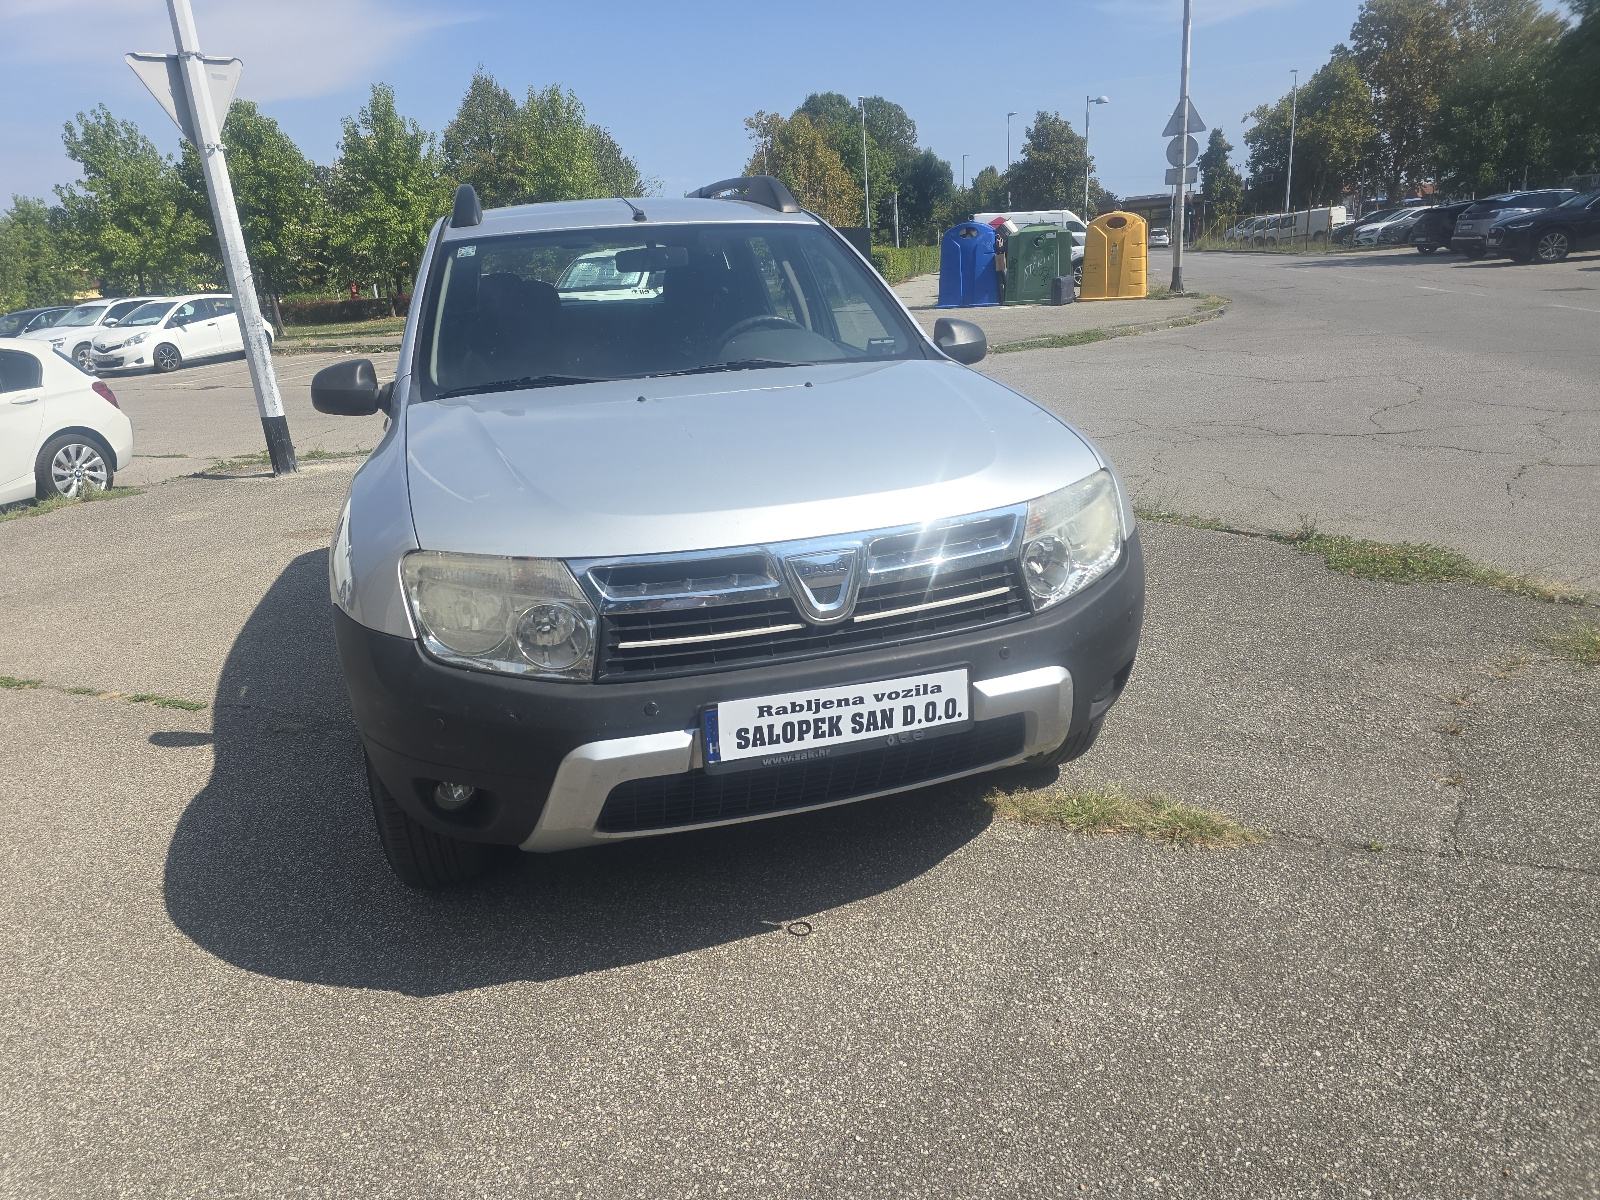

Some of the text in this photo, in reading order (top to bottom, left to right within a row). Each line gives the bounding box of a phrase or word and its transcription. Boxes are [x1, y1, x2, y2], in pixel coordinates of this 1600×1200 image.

[757, 683, 942, 719] Rabljena vozila
[736, 698, 963, 750] SALOPEK SAN D.O.O.
